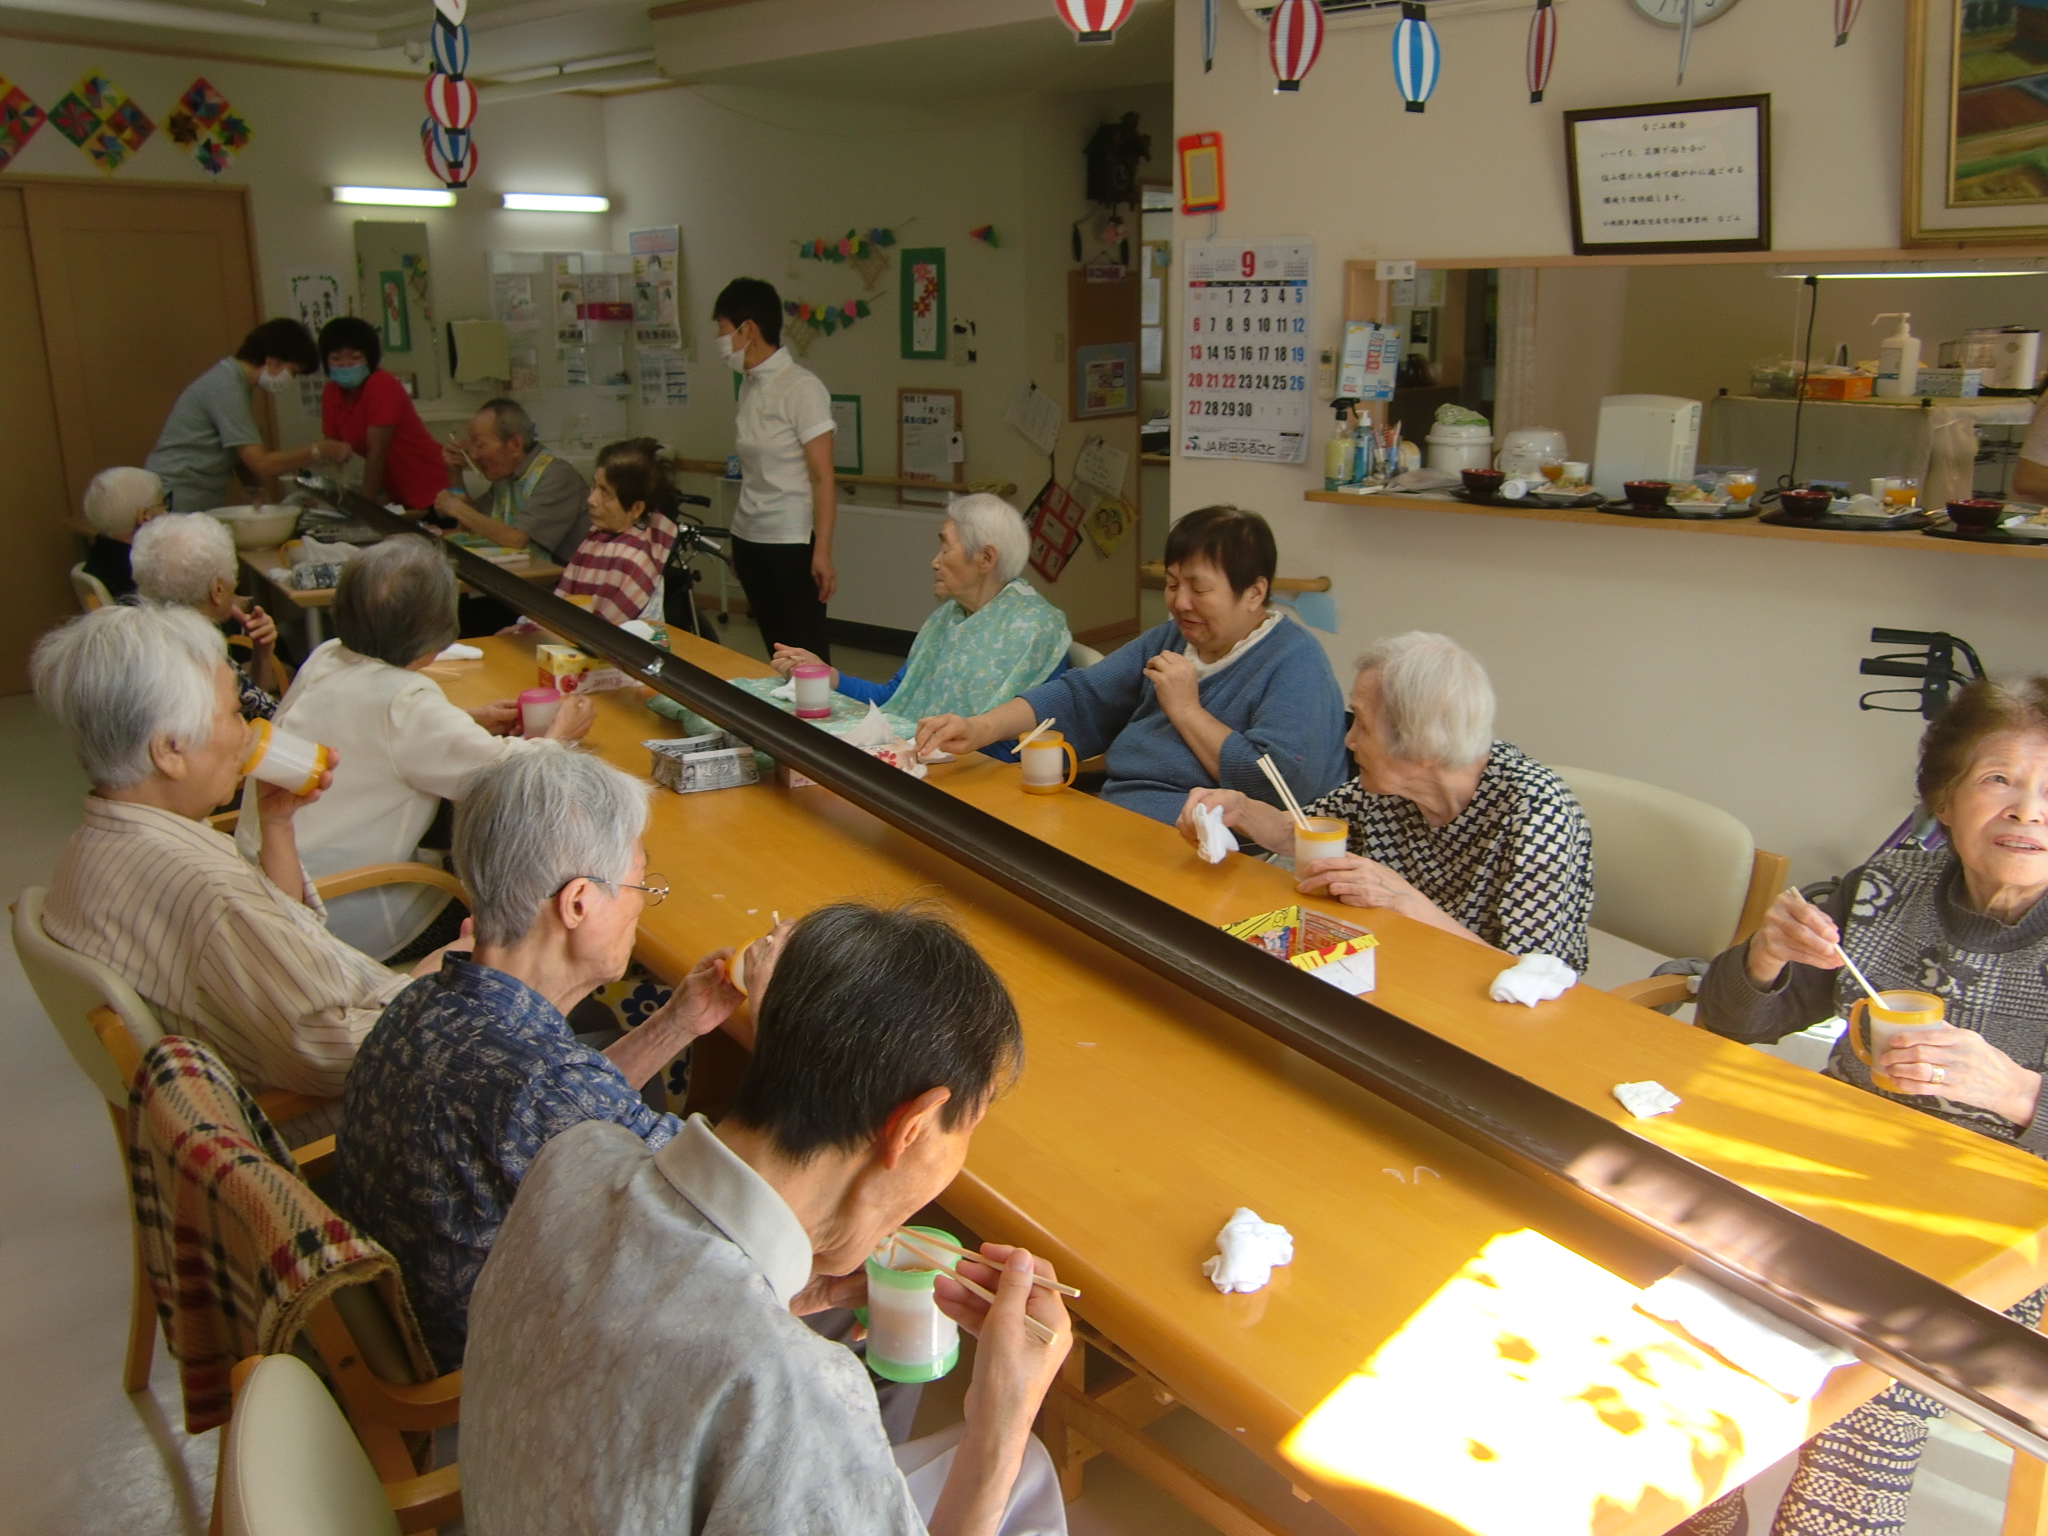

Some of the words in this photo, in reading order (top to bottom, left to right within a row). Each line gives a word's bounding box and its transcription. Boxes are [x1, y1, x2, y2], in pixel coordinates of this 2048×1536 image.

[1242, 251, 1255, 277] 9
[1228, 289, 1232, 303] 1
[1244, 288, 1251, 303] 2
[1262, 288, 1268, 304] 3
[1279, 288, 1285, 303] 4
[1296, 288, 1302, 304] 5
[1194, 317, 1200, 332] 6
[1210, 317, 1216, 331] 7
[1226, 317, 1233, 332] 8
[1244, 317, 1250, 332] 9
[1258, 317, 1270, 332] 10
[1277, 318, 1286, 332] 11
[1292, 317, 1305, 332] 12
[1190, 345, 1202, 360] 13
[1207, 345, 1219, 359] 14
[1224, 346, 1236, 360] 15
[1241, 346, 1252, 361] 16
[1258, 346, 1269, 360] 17
[1275, 346, 1286, 361] 18
[1292, 347, 1304, 362] 19
[1189, 373, 1203, 387] 20
[1207, 373, 1218, 388] 21
[1222, 373, 1236, 388] 22
[1239, 374, 1252, 389] 23
[1256, 375, 1269, 389] 24
[1272, 375, 1287, 390] 25
[1290, 376, 1304, 391] 26
[1189, 400, 1202, 415] 27
[1205, 401, 1218, 415] 28
[1221, 402, 1235, 416] 29
[1238, 402, 1252, 417] 30
[1203, 441, 1276, 456] JA秋田ふるさと
